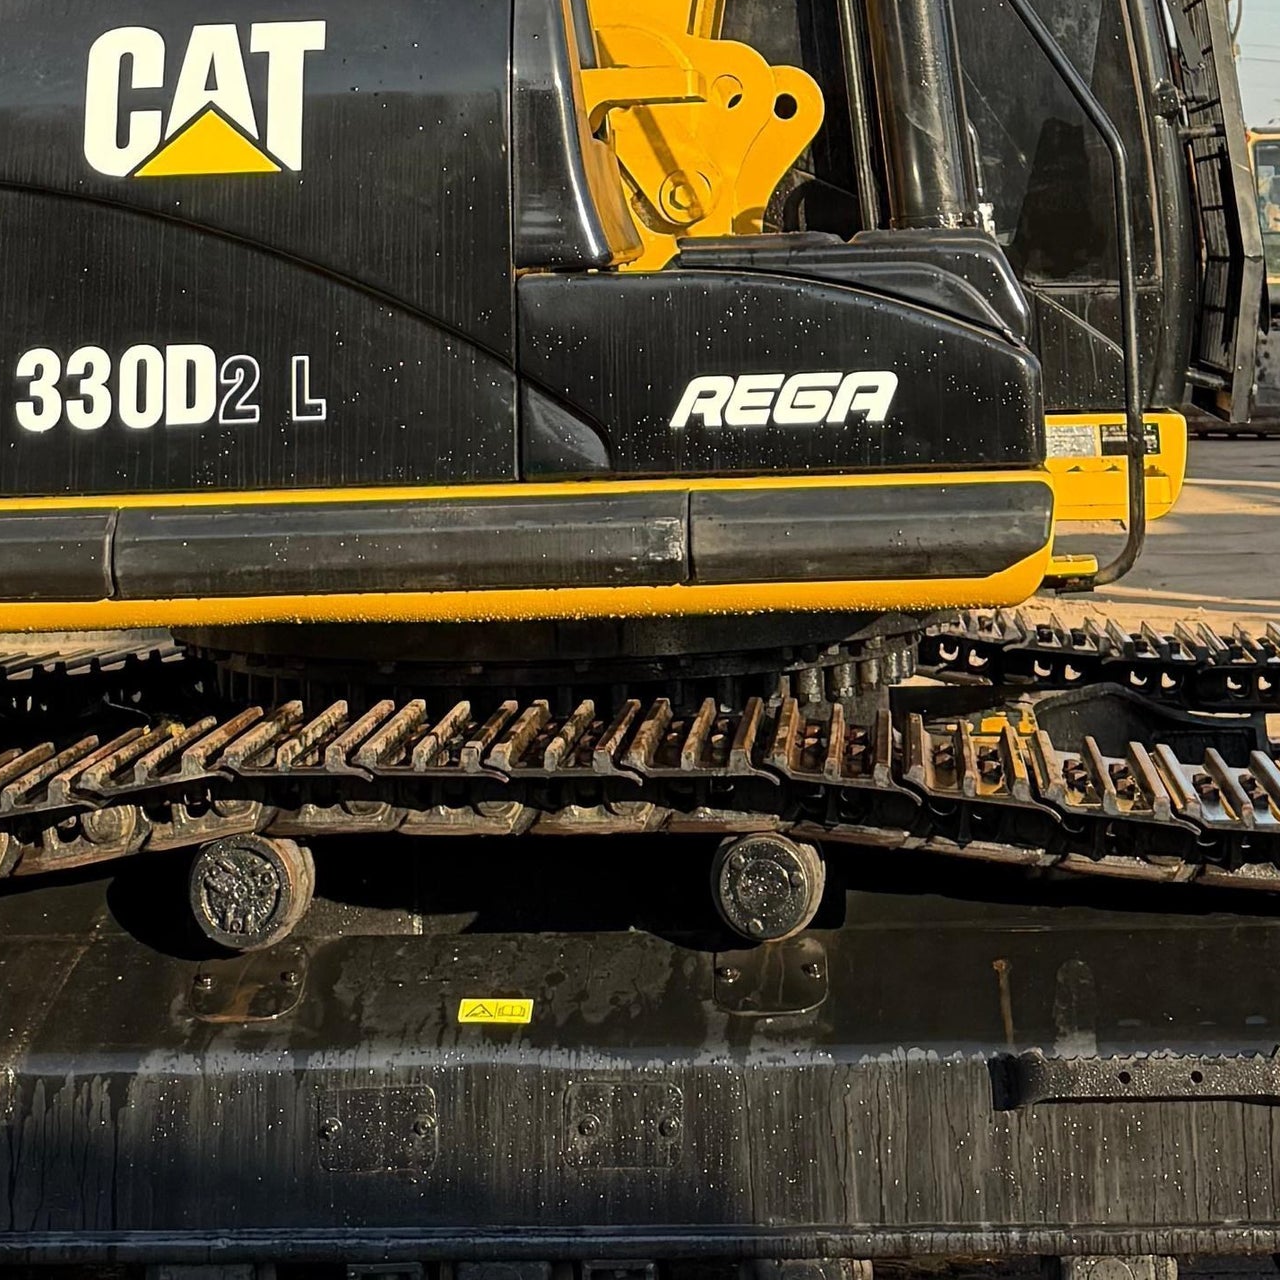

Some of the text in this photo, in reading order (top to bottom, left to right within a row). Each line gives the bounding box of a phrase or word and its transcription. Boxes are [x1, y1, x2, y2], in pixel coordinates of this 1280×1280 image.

[84, 20, 326, 177] CAT
[292, 355, 326, 421] L
[669, 370, 898, 427] REGA
